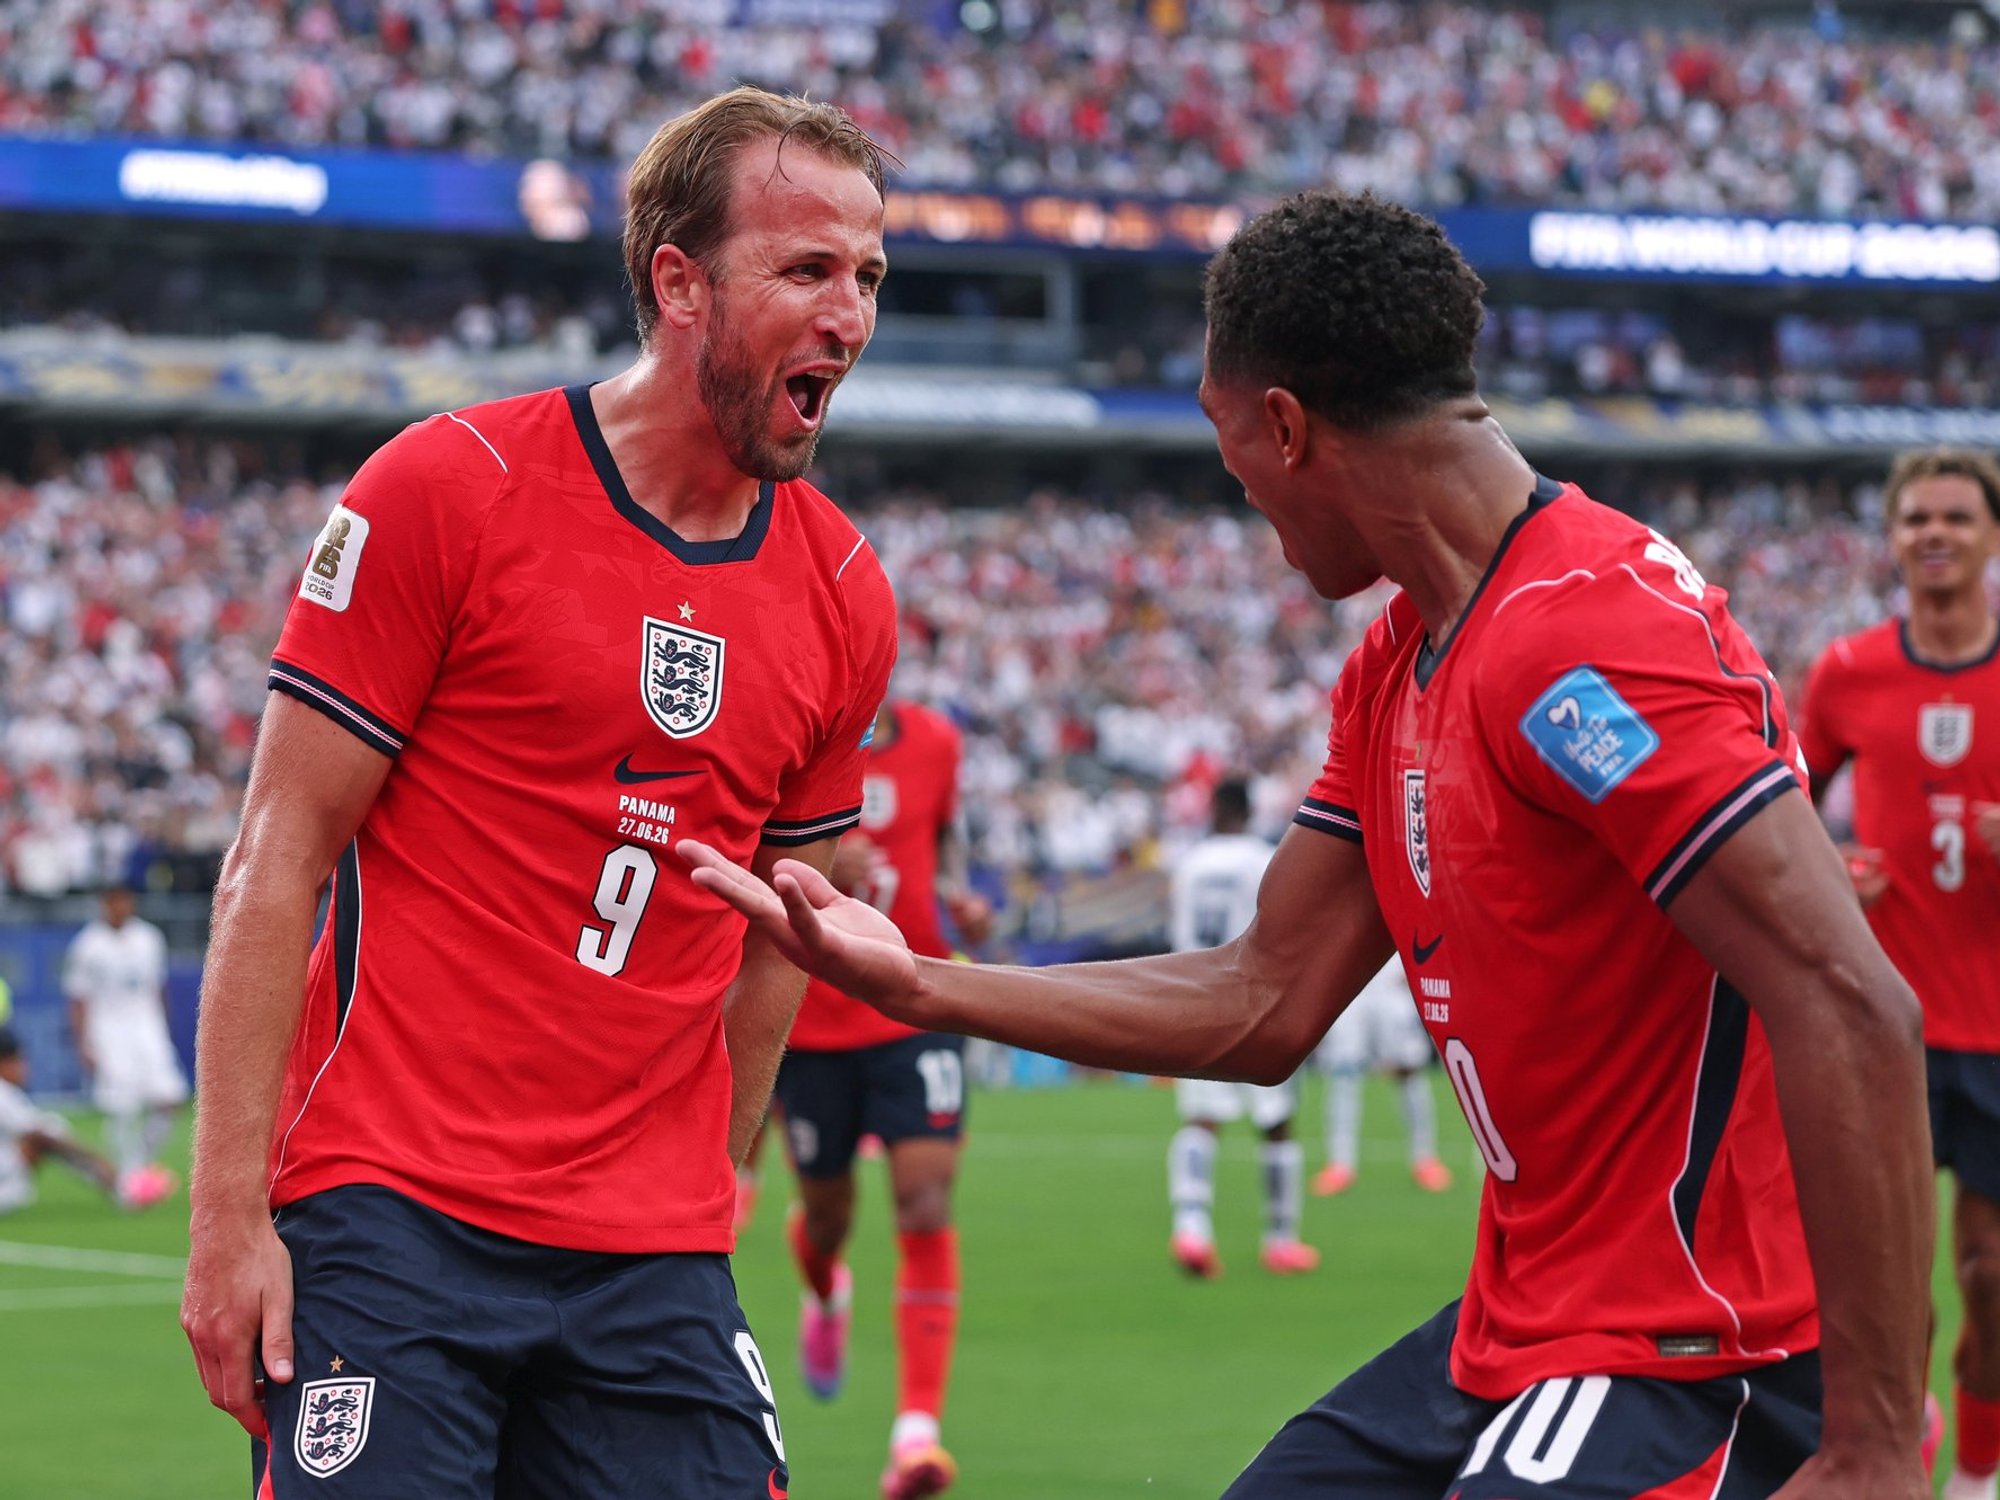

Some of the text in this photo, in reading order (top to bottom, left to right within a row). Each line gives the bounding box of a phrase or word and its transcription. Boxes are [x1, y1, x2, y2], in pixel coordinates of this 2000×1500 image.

[304, 582, 333, 601] 2026
[319, 562, 332, 574] FIFA
[1577, 728, 1624, 774] PEACE
[617, 816, 669, 845] 27.06.26
[618, 795, 675, 825] PANAMA
[1930, 819, 1966, 893] 3
[576, 843, 659, 977] 9
[1445, 1036, 1518, 1183] 0
[733, 1330, 786, 1464] 9
[1458, 1374, 1613, 1485] 10
